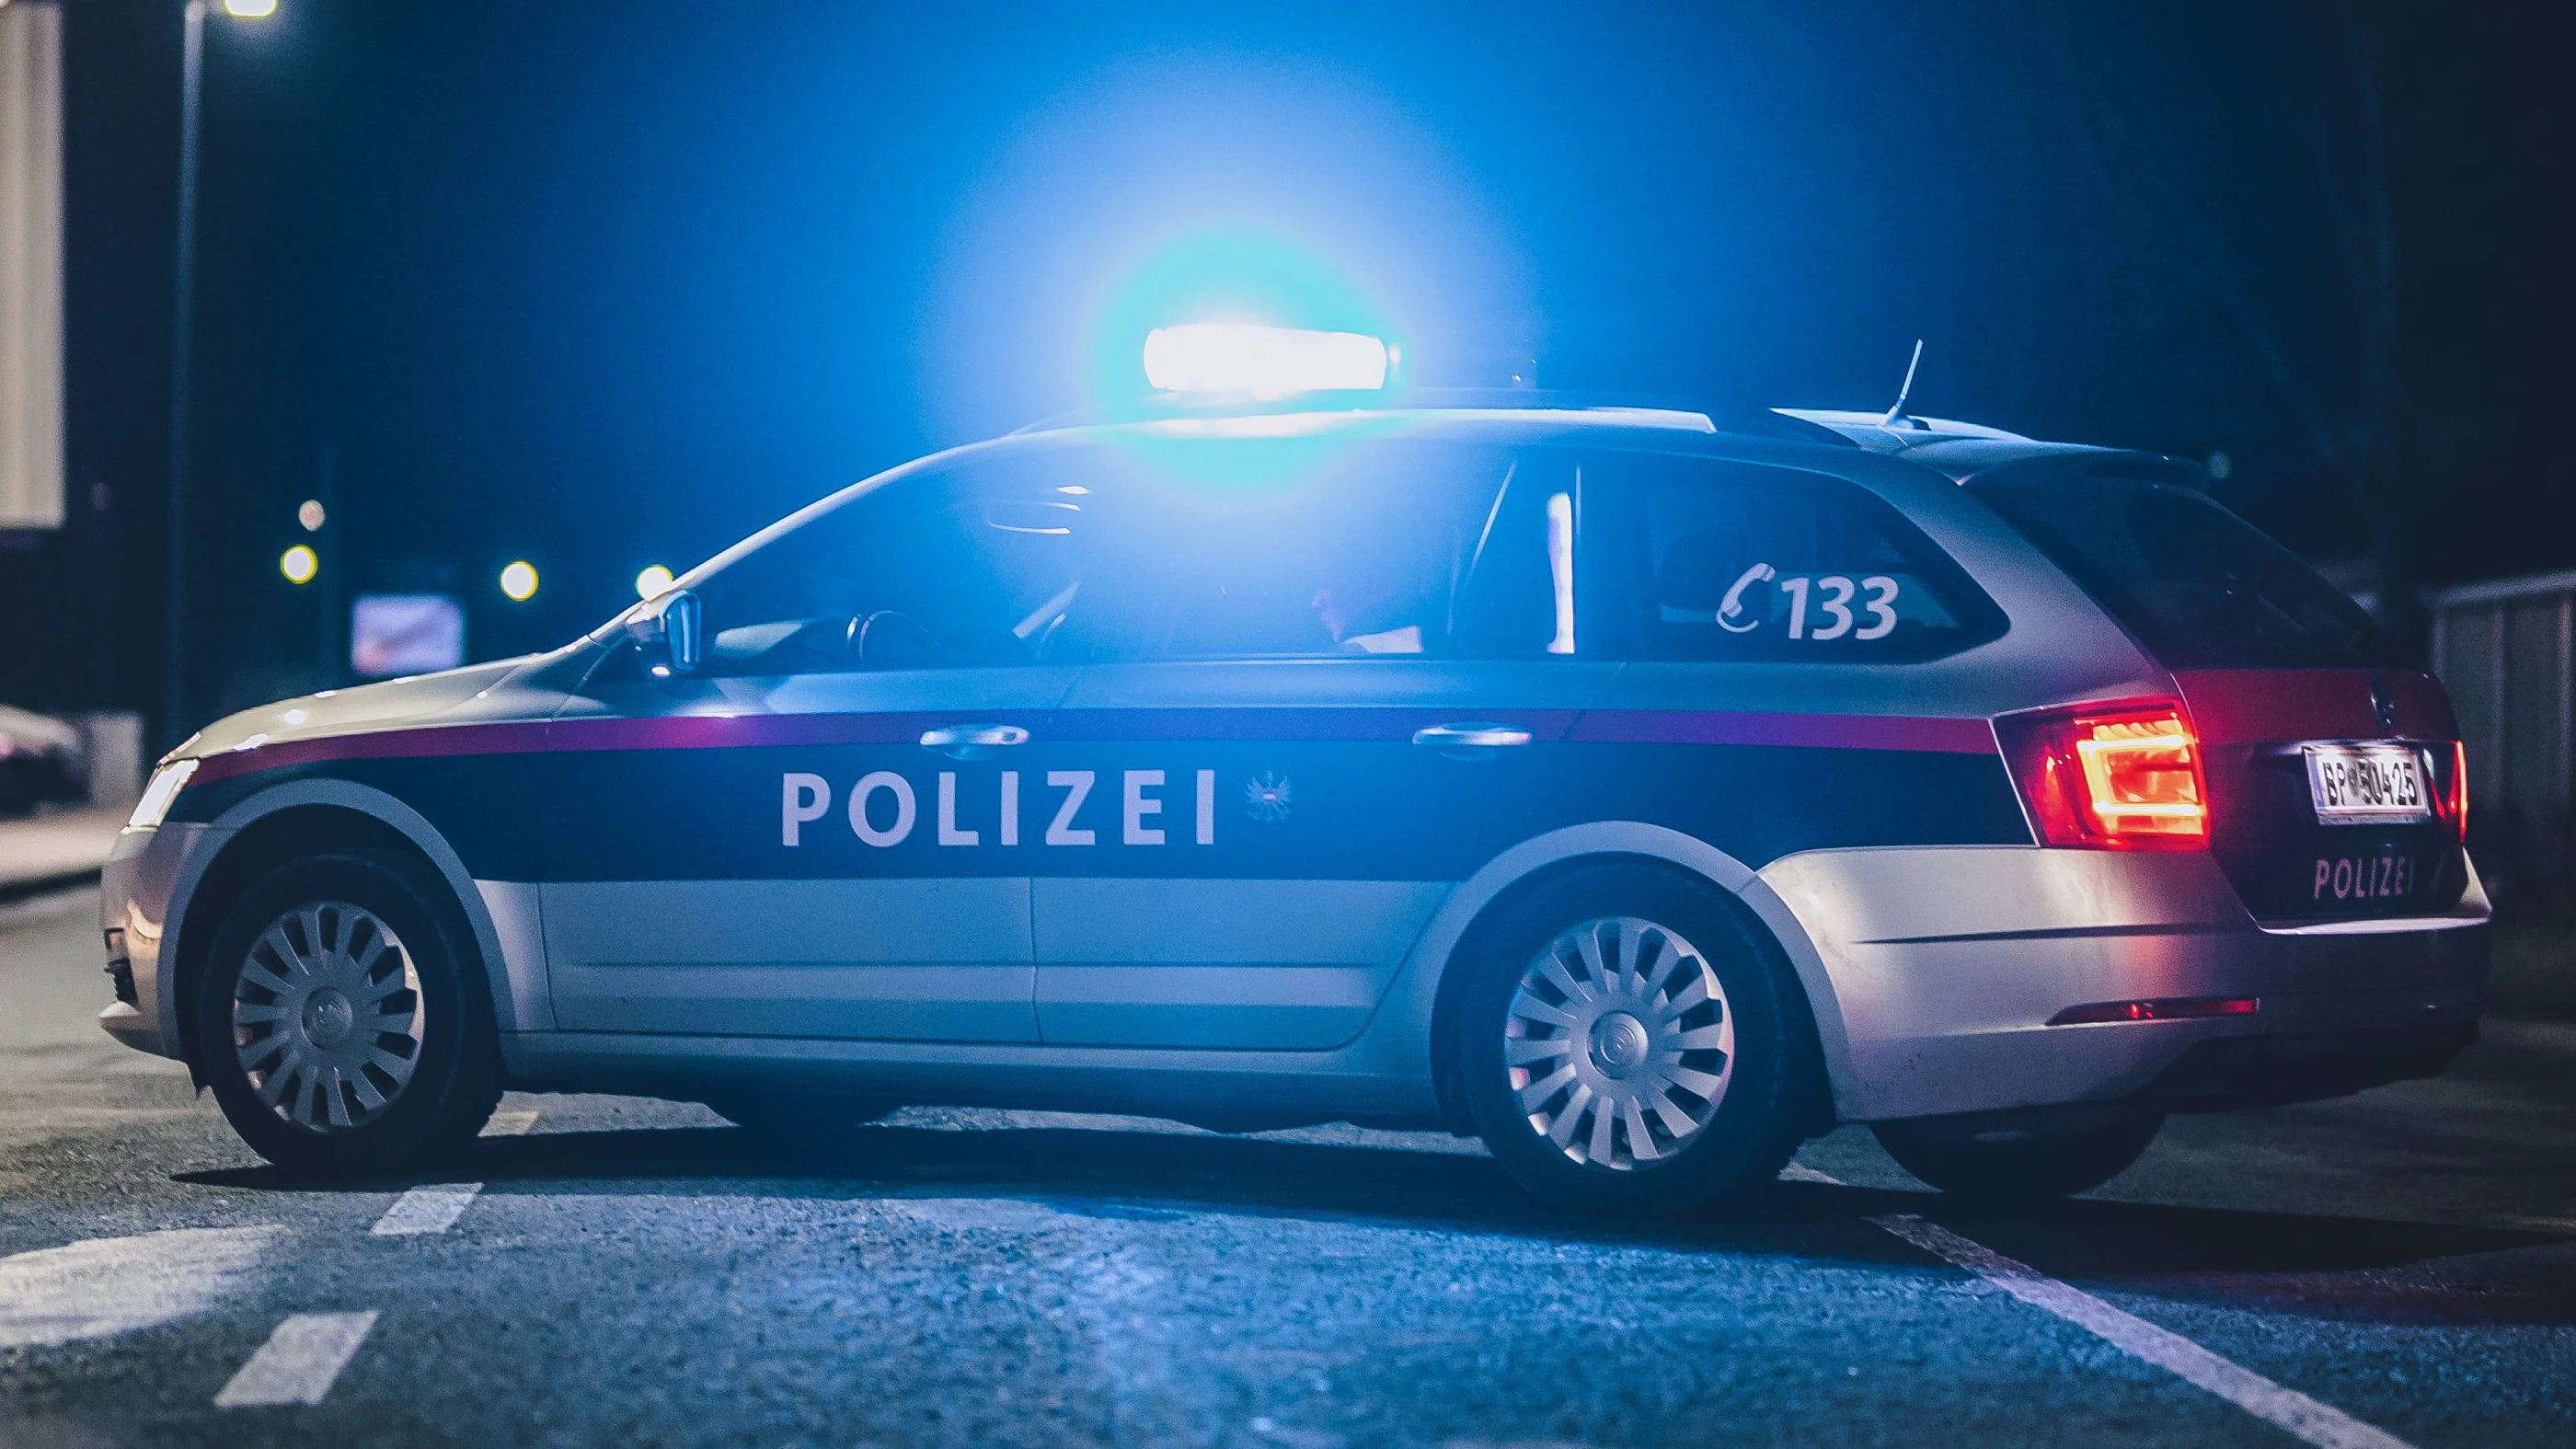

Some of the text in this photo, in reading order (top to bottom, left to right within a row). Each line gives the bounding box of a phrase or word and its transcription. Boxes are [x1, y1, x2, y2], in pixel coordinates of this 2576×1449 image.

[1781, 576, 1899, 640] 133
[782, 769, 1214, 846] POLIZEI
[2322, 762, 2346, 806] BP
[2314, 857, 2415, 900] POLIZEI
